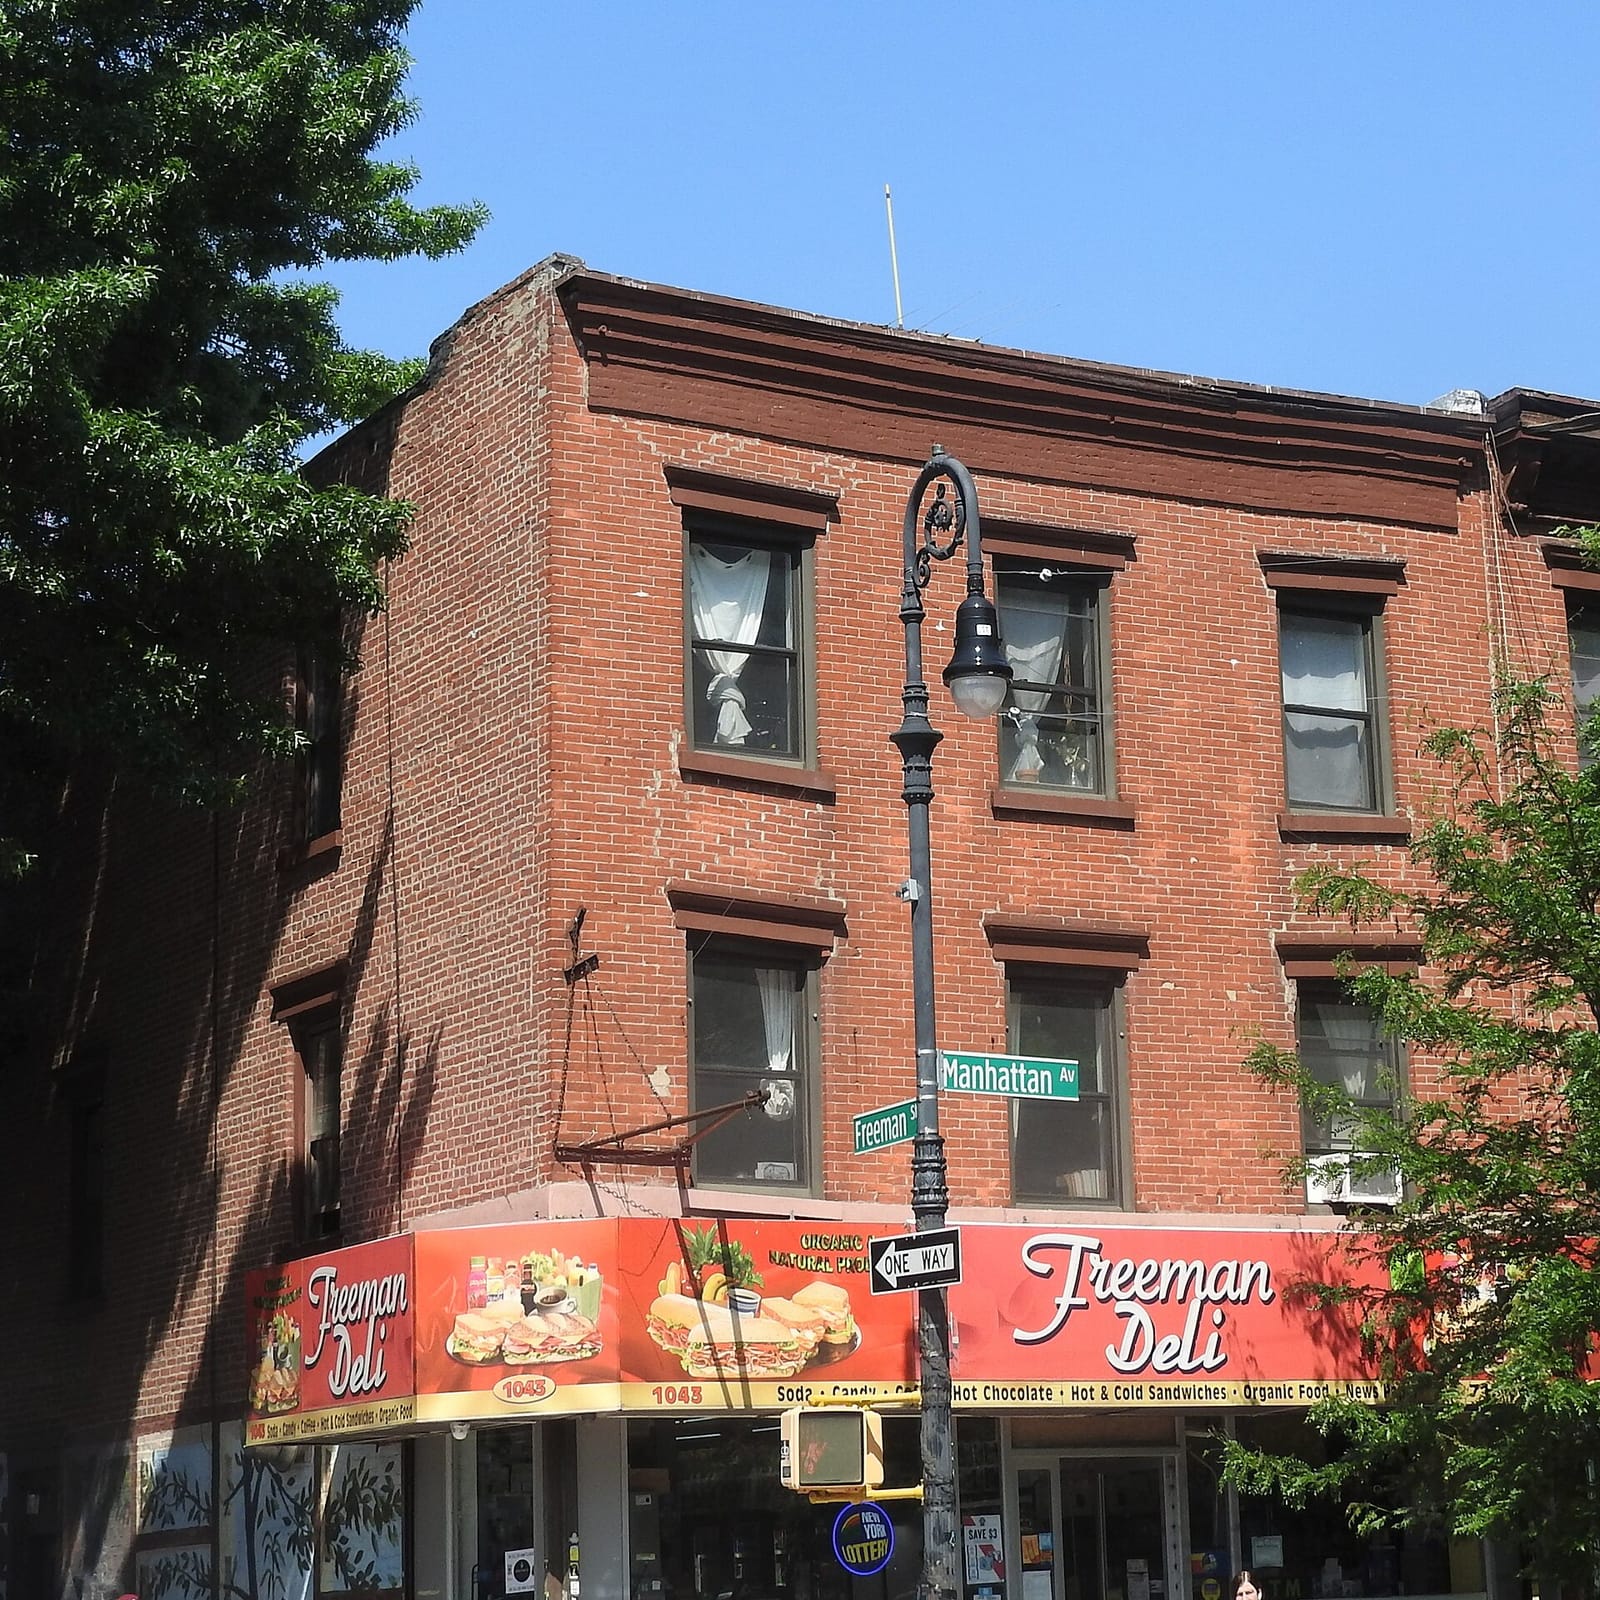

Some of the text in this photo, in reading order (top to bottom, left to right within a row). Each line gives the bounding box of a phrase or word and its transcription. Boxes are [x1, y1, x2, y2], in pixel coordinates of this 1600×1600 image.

[943, 1058, 1075, 1095] Manhattan Av
[855, 1112, 907, 1150] Freeman
[800, 1234, 864, 1252] ORGANIC
[769, 1250, 834, 1272] NATURAL
[884, 1247, 949, 1276] ONE WAY
[1013, 1233, 1275, 1345] Freeman
[304, 1266, 408, 1368] Freeman
[1105, 1299, 1229, 1375] Deli
[328, 1315, 388, 1397] Deli
[502, 1378, 546, 1398] 1043
[652, 1386, 703, 1404] 1043
[777, 1385, 813, 1401] Soda
[952, 1384, 978, 1400] Hot
[983, 1384, 1053, 1401] Chocolate
[1071, 1385, 1095, 1401] Hot
[1101, 1385, 1109, 1401] &
[1114, 1385, 1143, 1401] Cold
[1149, 1384, 1227, 1401] Sandwiches
[1243, 1384, 1294, 1402] Organic
[1299, 1384, 1329, 1400] Food
[1346, 1384, 1379, 1400] News
[250, 1424, 266, 1440] 1043
[267, 1424, 279, 1439] Soda
[282, 1422, 297, 1438] Candy
[301, 1418, 316, 1434] Coffee
[320, 1416, 330, 1431] Hot
[334, 1413, 346, 1429] Cold
[346, 1409, 375, 1428] Sandwiches
[379, 1405, 399, 1425] Organic
[400, 1404, 413, 1420] Food
[861, 1511, 881, 1524] NEW
[863, 1524, 887, 1540] YORK
[968, 1528, 998, 1541] SAVE $3
[841, 1538, 889, 1564] LOTTERY
